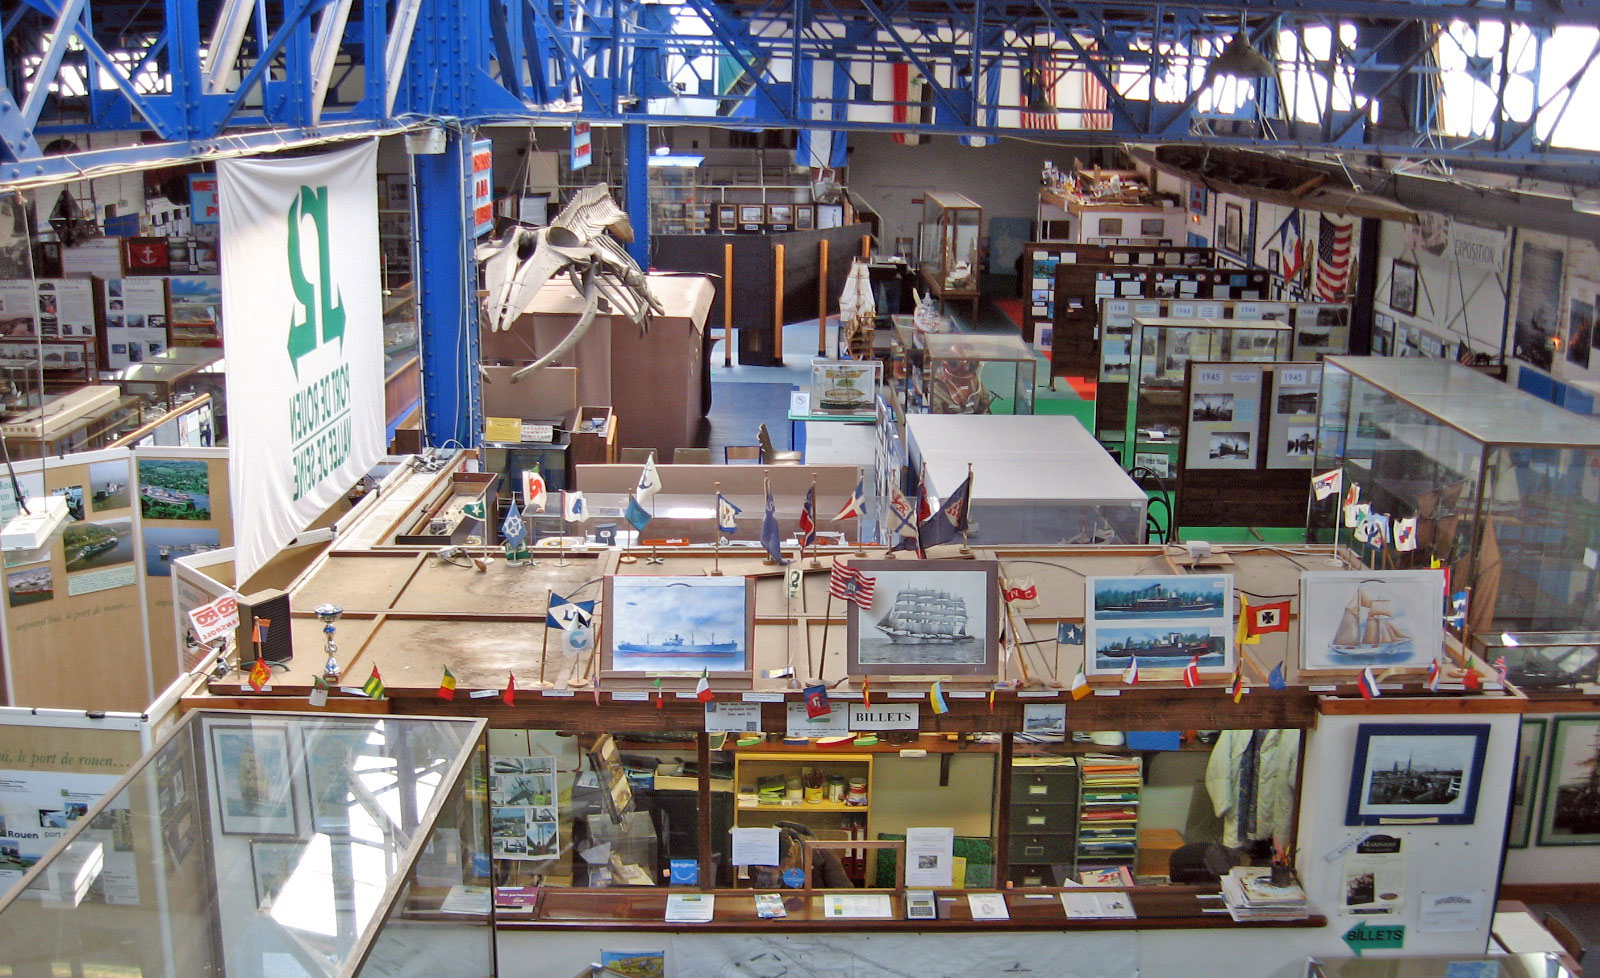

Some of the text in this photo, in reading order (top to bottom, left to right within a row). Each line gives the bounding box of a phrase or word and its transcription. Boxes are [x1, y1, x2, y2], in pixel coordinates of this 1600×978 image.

[1455, 239, 1495, 265] EXPOSITION
[1202, 372, 1220, 381] 1945
[1284, 372, 1302, 381] 1945
[856, 712, 911, 722] BILLETS
[18, 750, 25, 763] le
[31, 751, 56, 767] port
[61, 752, 72, 764] de
[8, 830, 38, 840] Rouen
[1347, 929, 1403, 941] BILLETS
